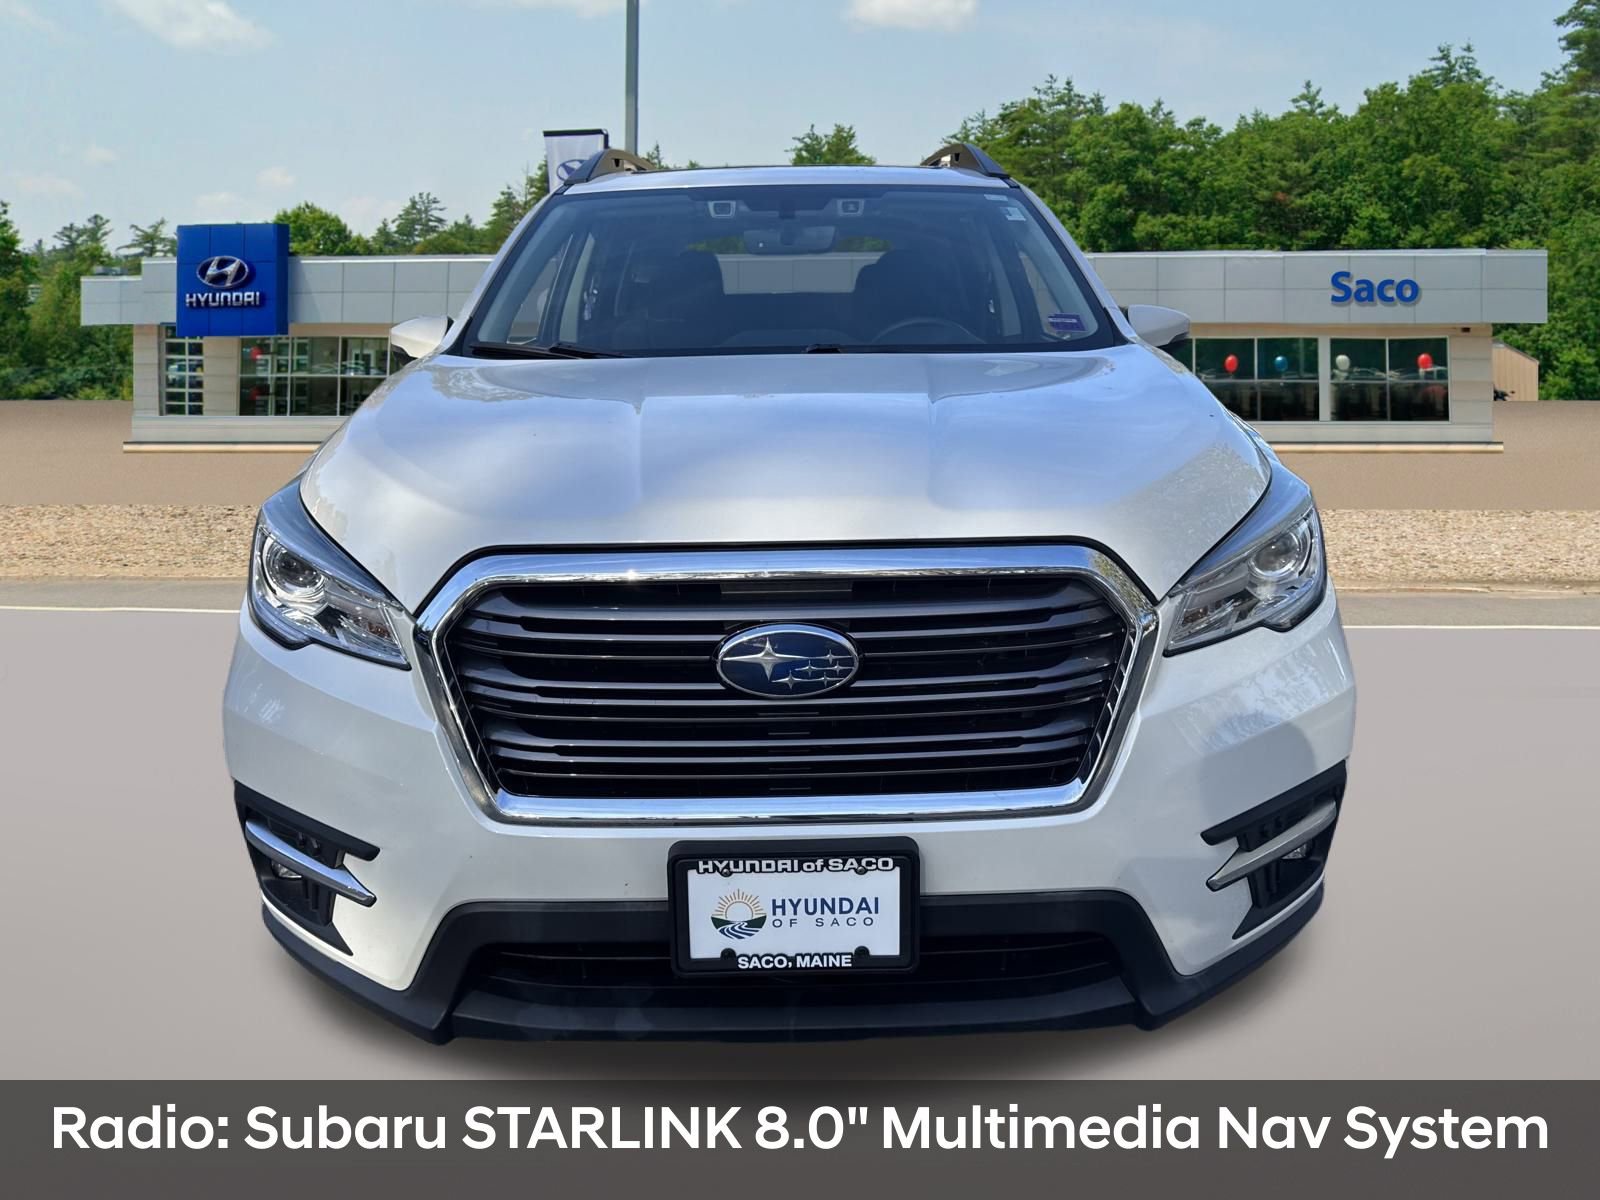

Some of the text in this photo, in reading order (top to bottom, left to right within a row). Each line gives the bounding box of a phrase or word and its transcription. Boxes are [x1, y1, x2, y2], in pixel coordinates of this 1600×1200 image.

[1330, 270, 1420, 303] Saco
[185, 291, 260, 307] HYUNDAI
[698, 857, 894, 873] HYUNDAI of SACO
[771, 897, 879, 916] HYUNDAI
[772, 917, 874, 928] OF SACO
[738, 954, 852, 969] SACO, MAINE
